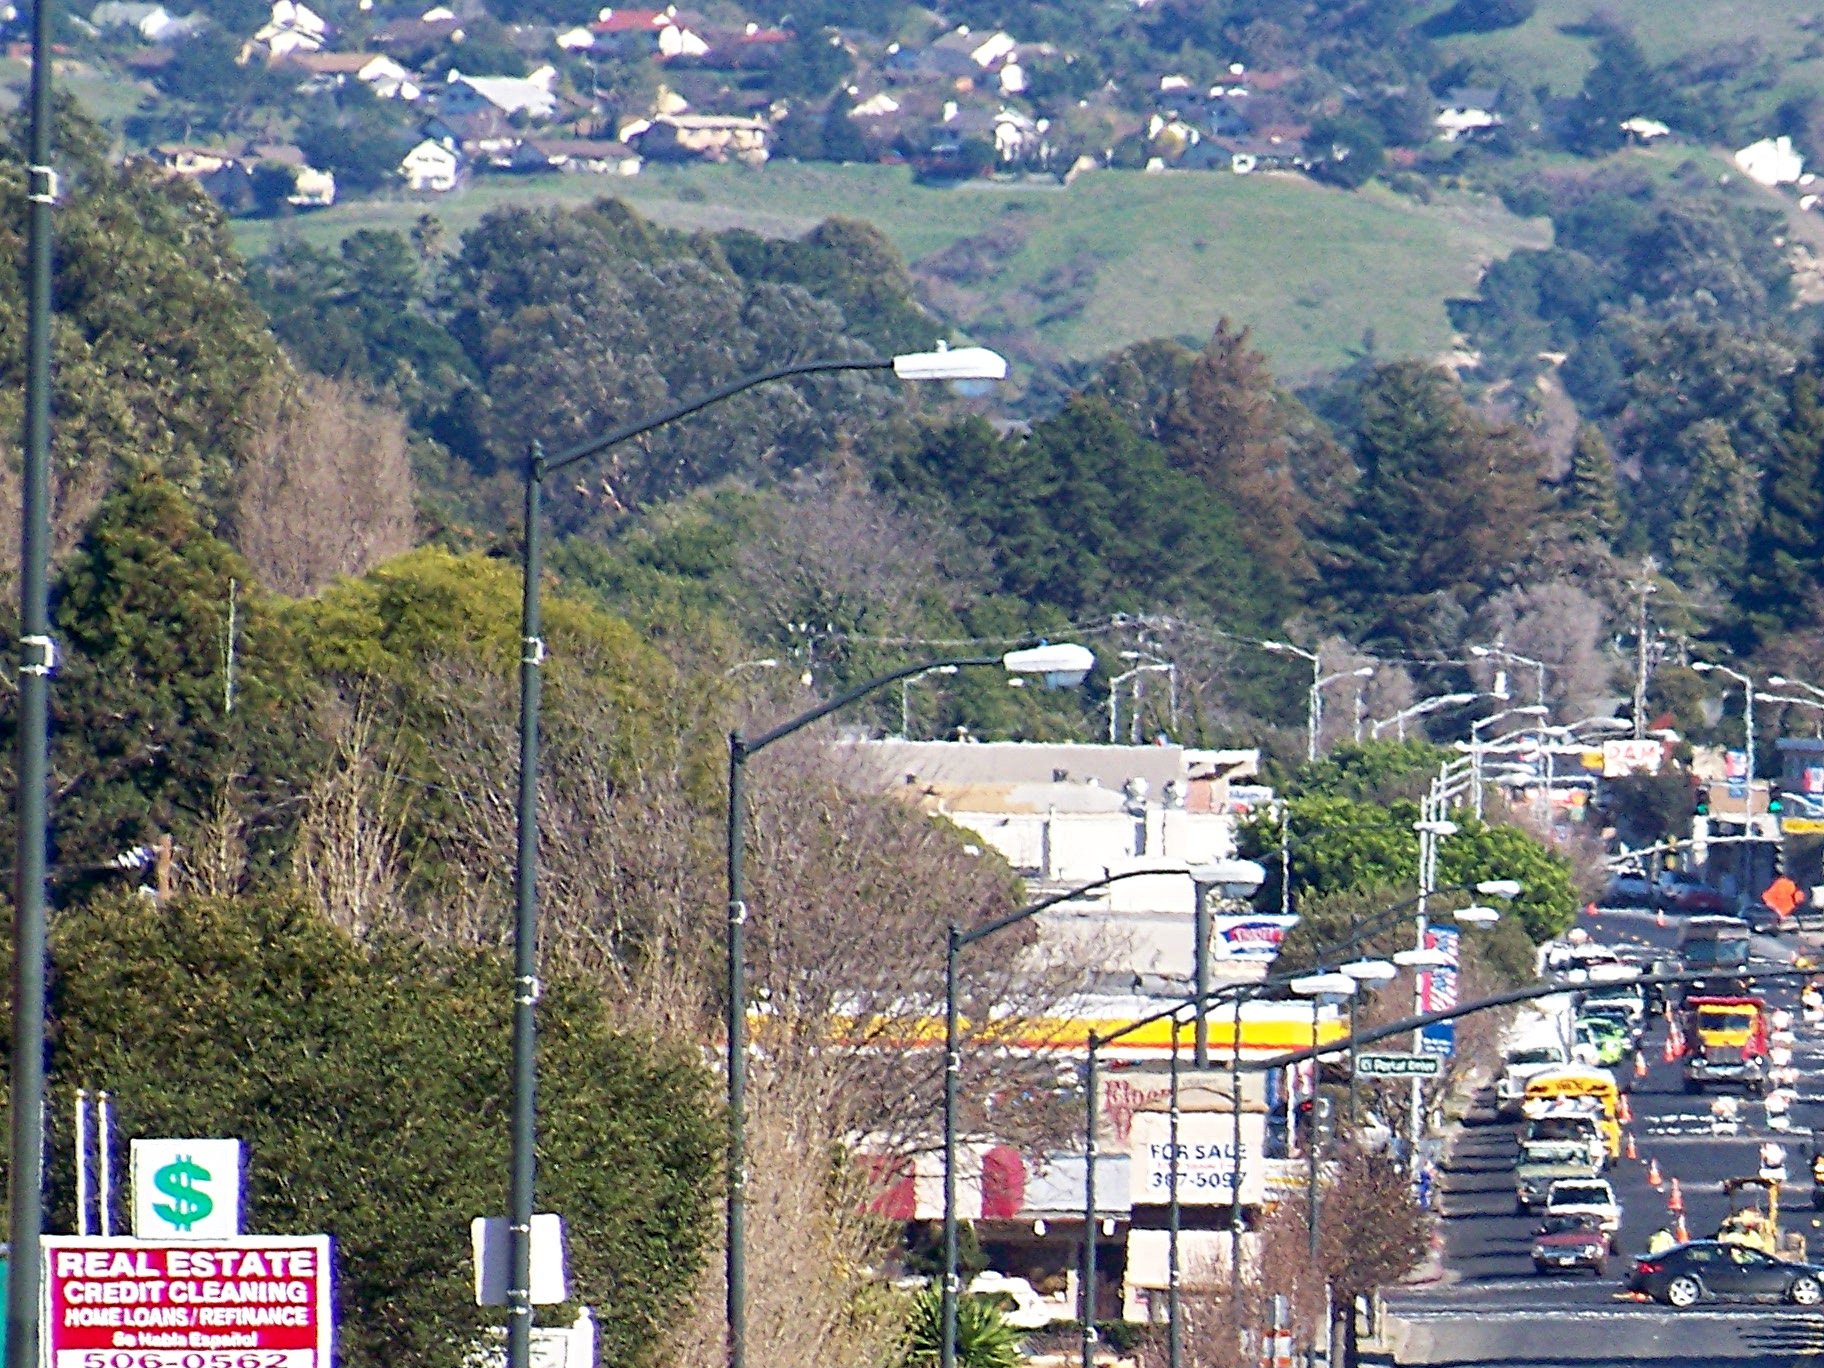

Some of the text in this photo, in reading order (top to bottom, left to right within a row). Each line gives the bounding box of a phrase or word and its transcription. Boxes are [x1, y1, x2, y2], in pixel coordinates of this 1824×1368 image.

[1151, 1143, 1247, 1160] FOR SALE
[57, 1251, 316, 1278] REAL ESTATE
[63, 1281, 308, 1304] CREDIT CLEANING
[64, 1307, 122, 1327] HOME
[123, 1307, 190, 1327] LOANS
[200, 1306, 309, 1327] REFINANCE
[112, 1331, 258, 1350] Se Habla Español
